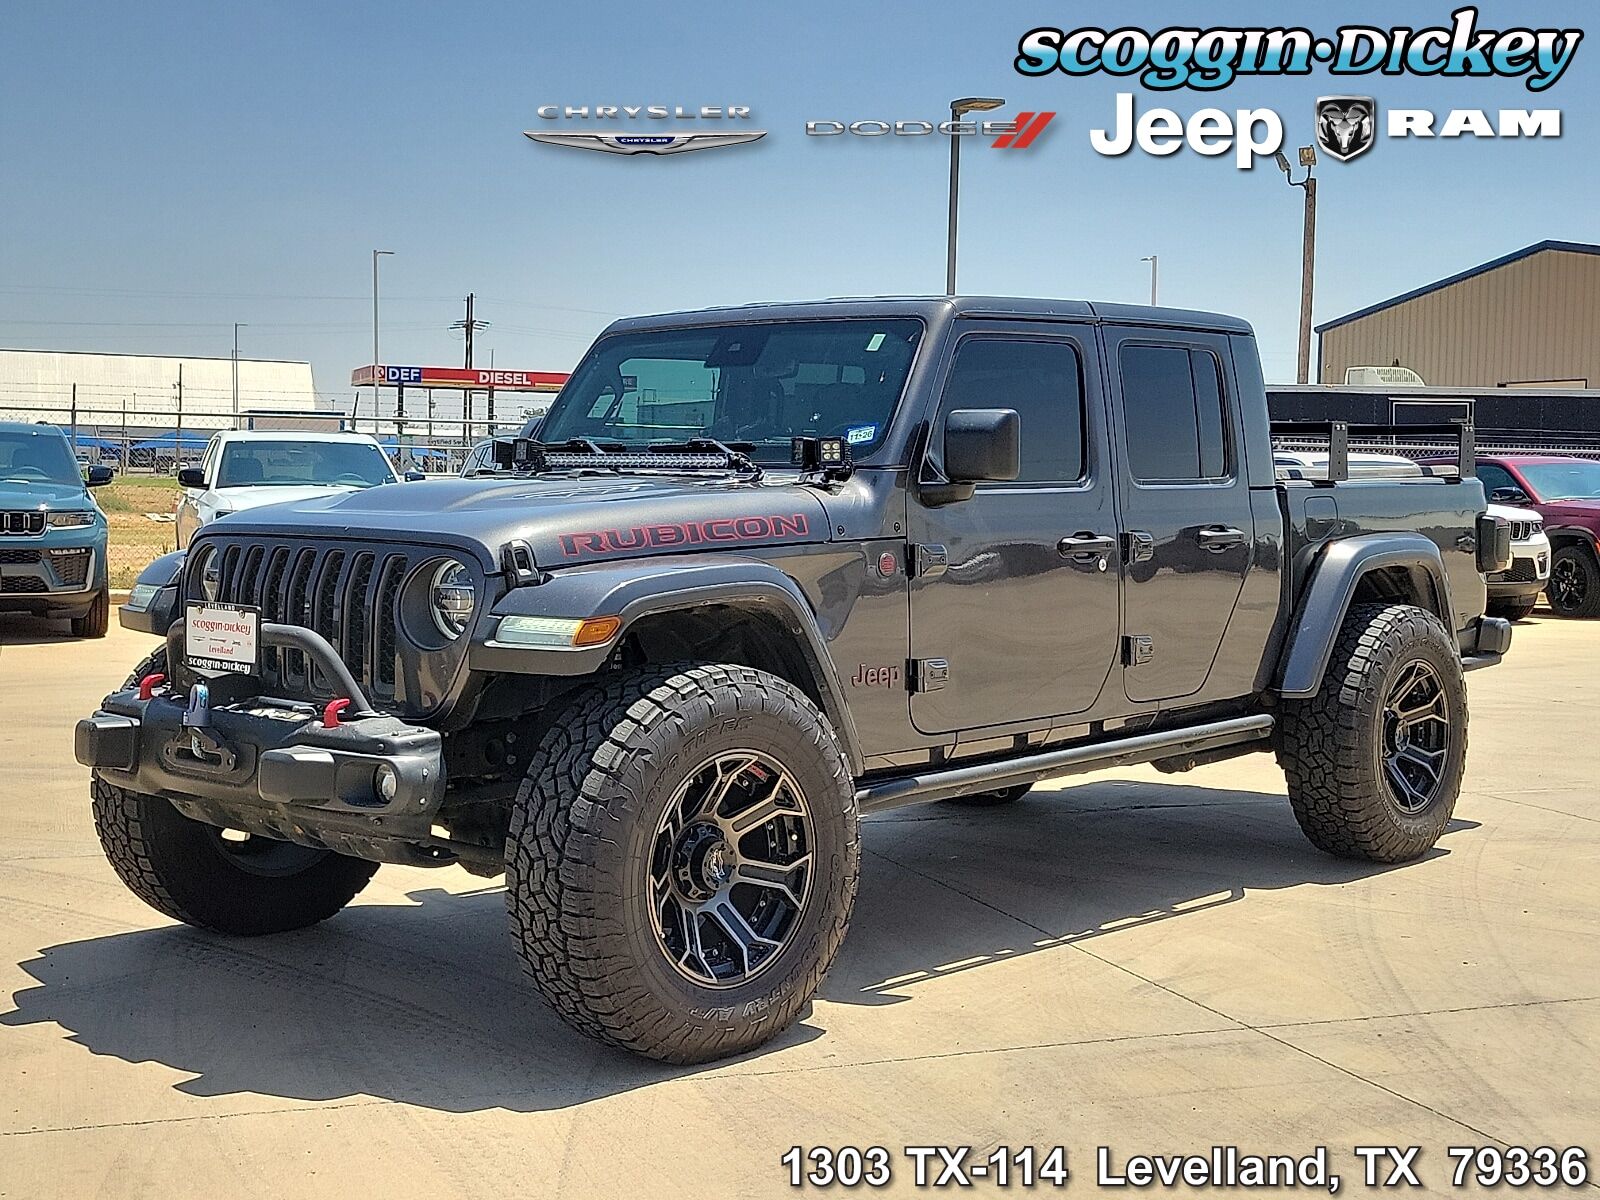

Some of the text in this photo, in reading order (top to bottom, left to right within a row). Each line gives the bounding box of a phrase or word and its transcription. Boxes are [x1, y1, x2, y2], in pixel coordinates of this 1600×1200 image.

[388, 368, 420, 380] DEF
[479, 371, 531, 385] DIESEL
[559, 514, 809, 556] RUBICON
[204, 602, 236, 611] LEVELLAND
[208, 645, 234, 655] Levelland
[851, 662, 898, 689] Jeep
